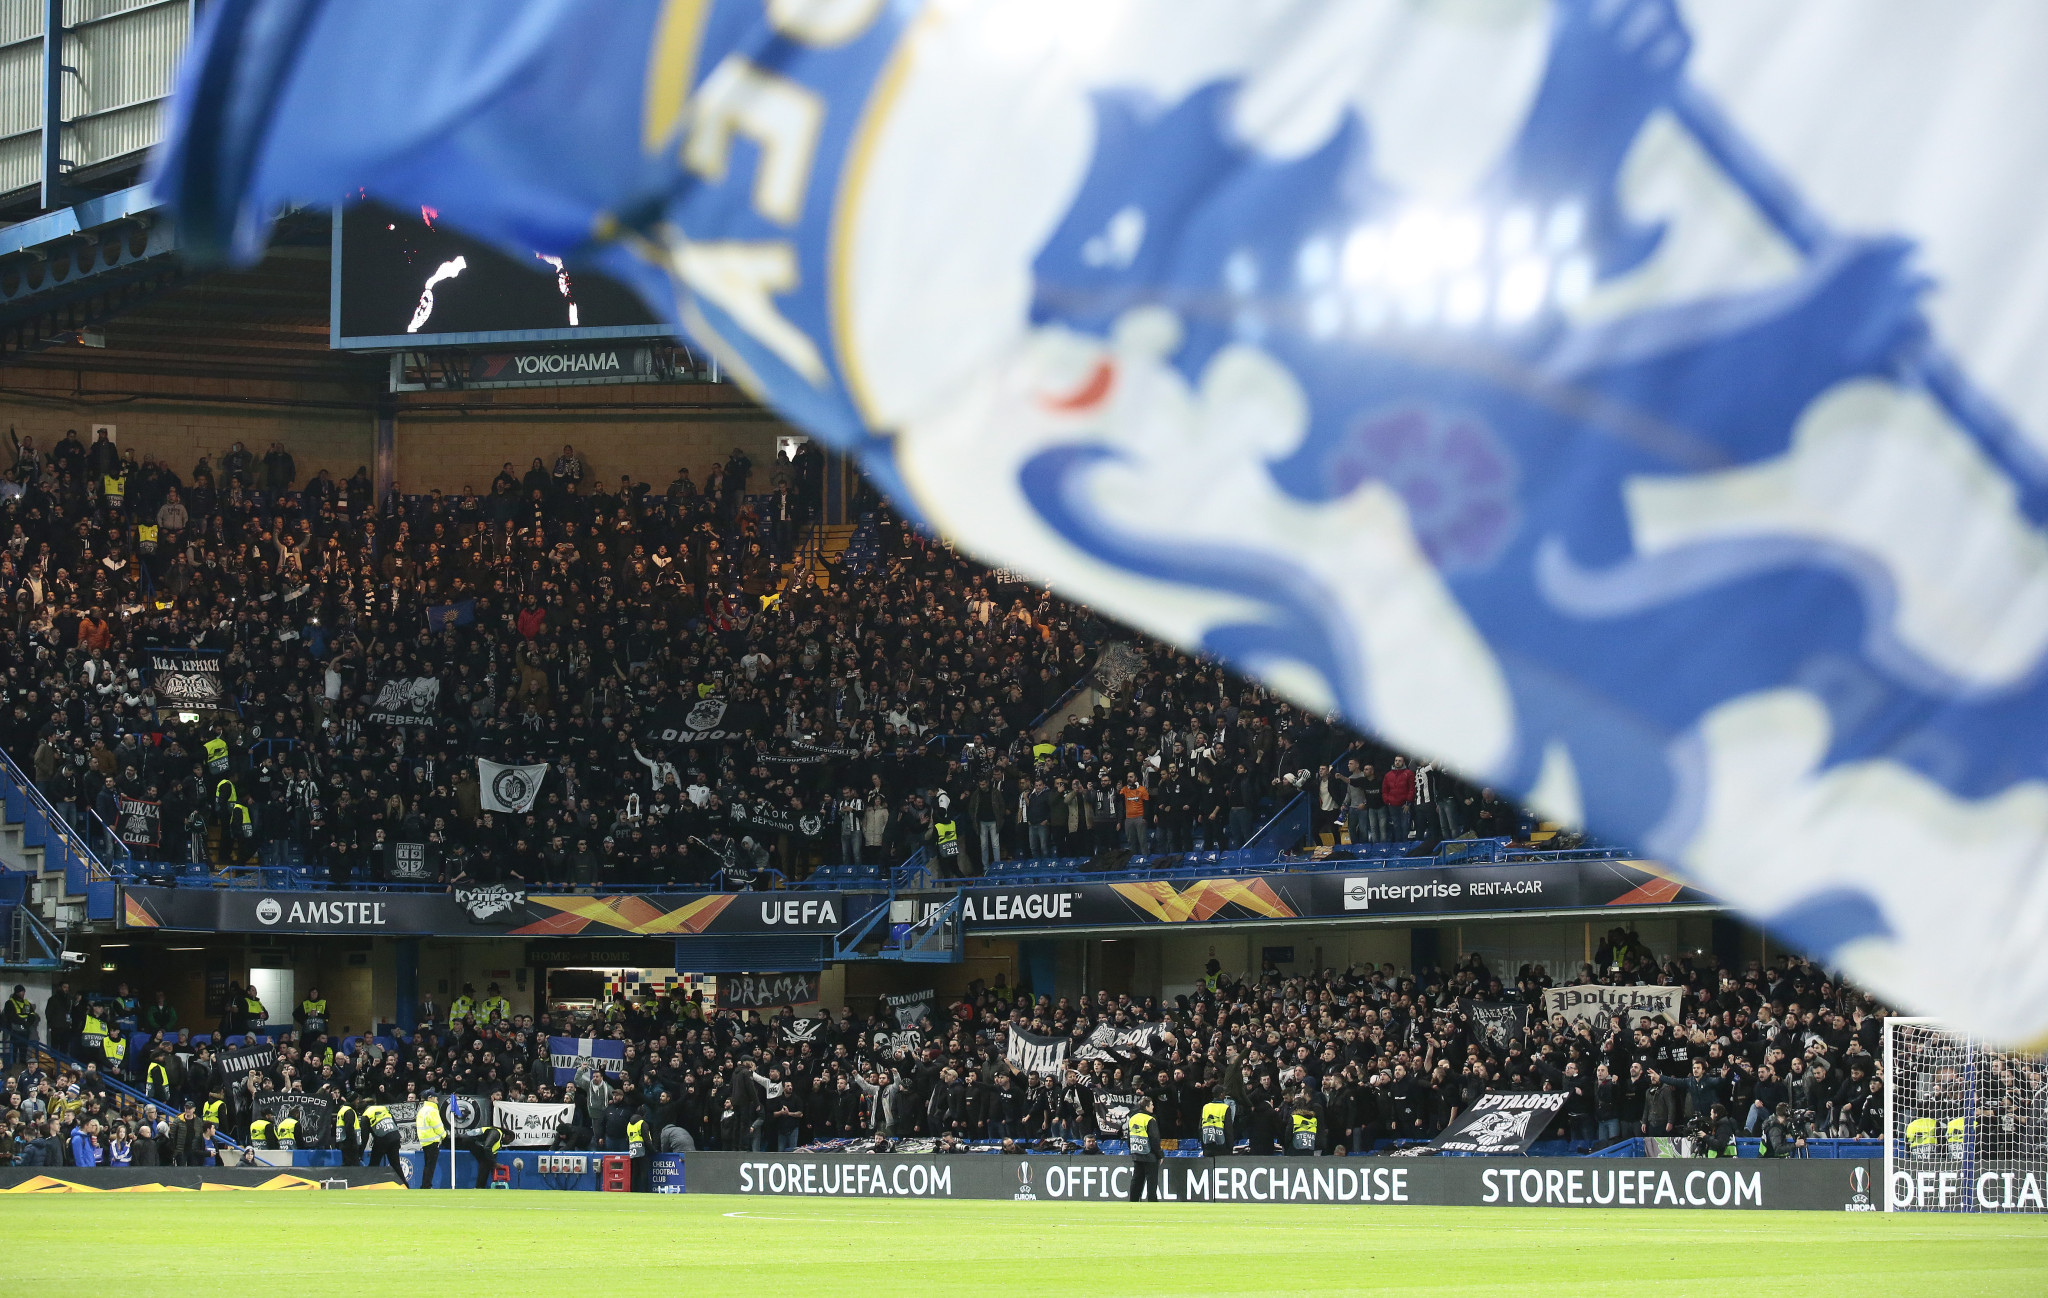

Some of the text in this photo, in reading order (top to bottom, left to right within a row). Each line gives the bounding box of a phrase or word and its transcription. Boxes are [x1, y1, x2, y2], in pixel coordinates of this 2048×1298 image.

[514, 351, 620, 374] YOKOHAMA
[647, 728, 743, 743] LONDON
[123, 832, 150, 844] CLUB
[1469, 880, 1543, 896] RENT-A-CAR
[287, 901, 386, 925] AMSTEL
[761, 899, 838, 925] UEFA
[982, 893, 1072, 921] LEAGUE
[591, 951, 630, 961] HOME
[730, 975, 809, 1006] DRAMA
[1471, 1091, 1569, 1112] EPTALOFOS
[1441, 1142, 1474, 1151] NEVER
[652, 1160, 676, 1168] CHELSEA
[739, 1162, 951, 1196] STORE.UEFA.COM
[1186, 1167, 1409, 1201] MERCHANDISE
[1481, 1168, 1763, 1206] STORE.UEFA.COM
[1893, 1170, 2048, 1209] OFFCIA
[1014, 1193, 1037, 1201] EUROPA
[1845, 1203, 1877, 1212] EUROPA
